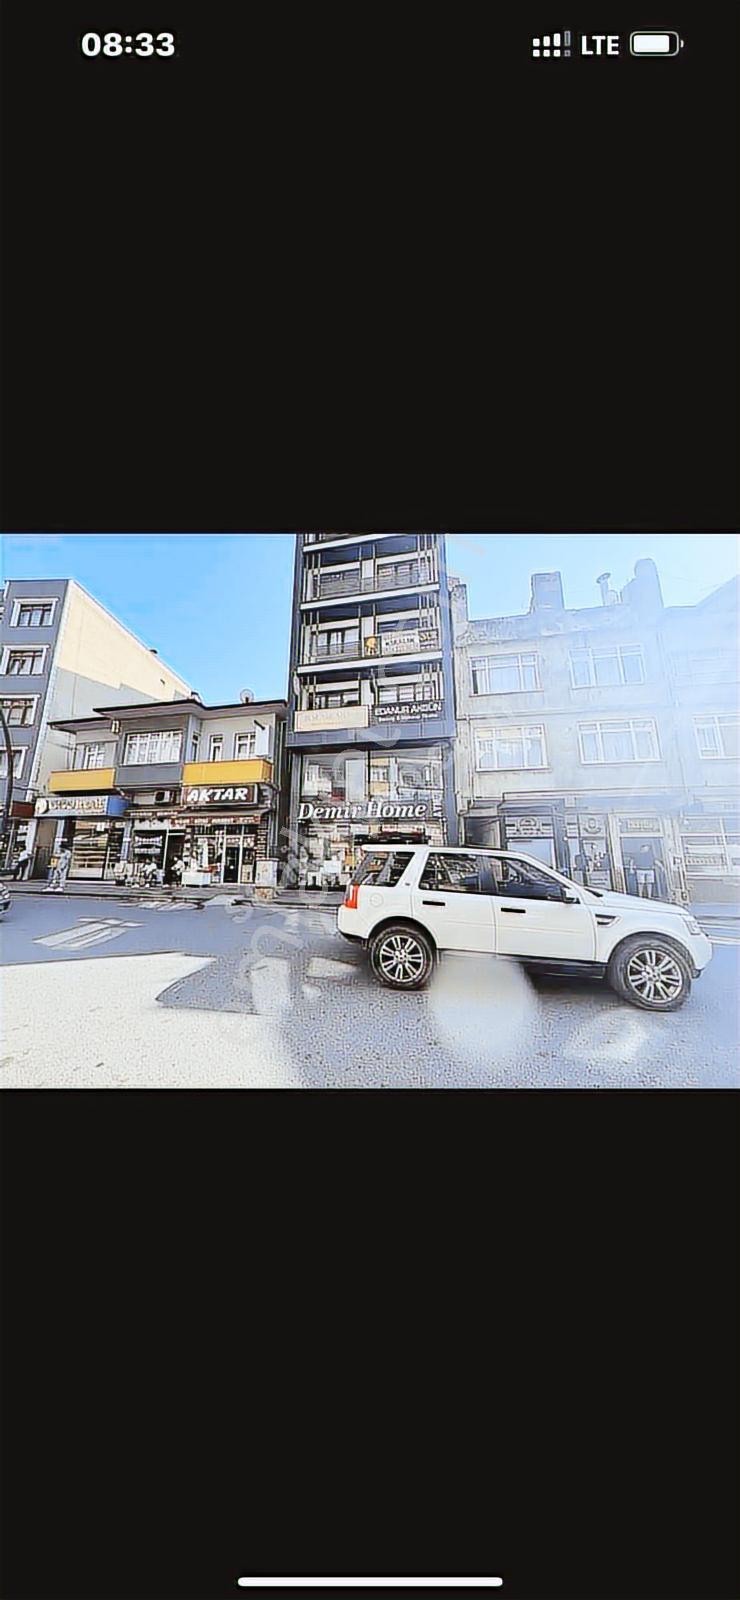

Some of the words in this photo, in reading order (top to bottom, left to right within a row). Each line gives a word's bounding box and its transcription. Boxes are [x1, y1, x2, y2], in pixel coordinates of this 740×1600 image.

[187, 787, 249, 802] AKTAR
[298, 802, 362, 820] Demir
[366, 800, 427, 819] Home
